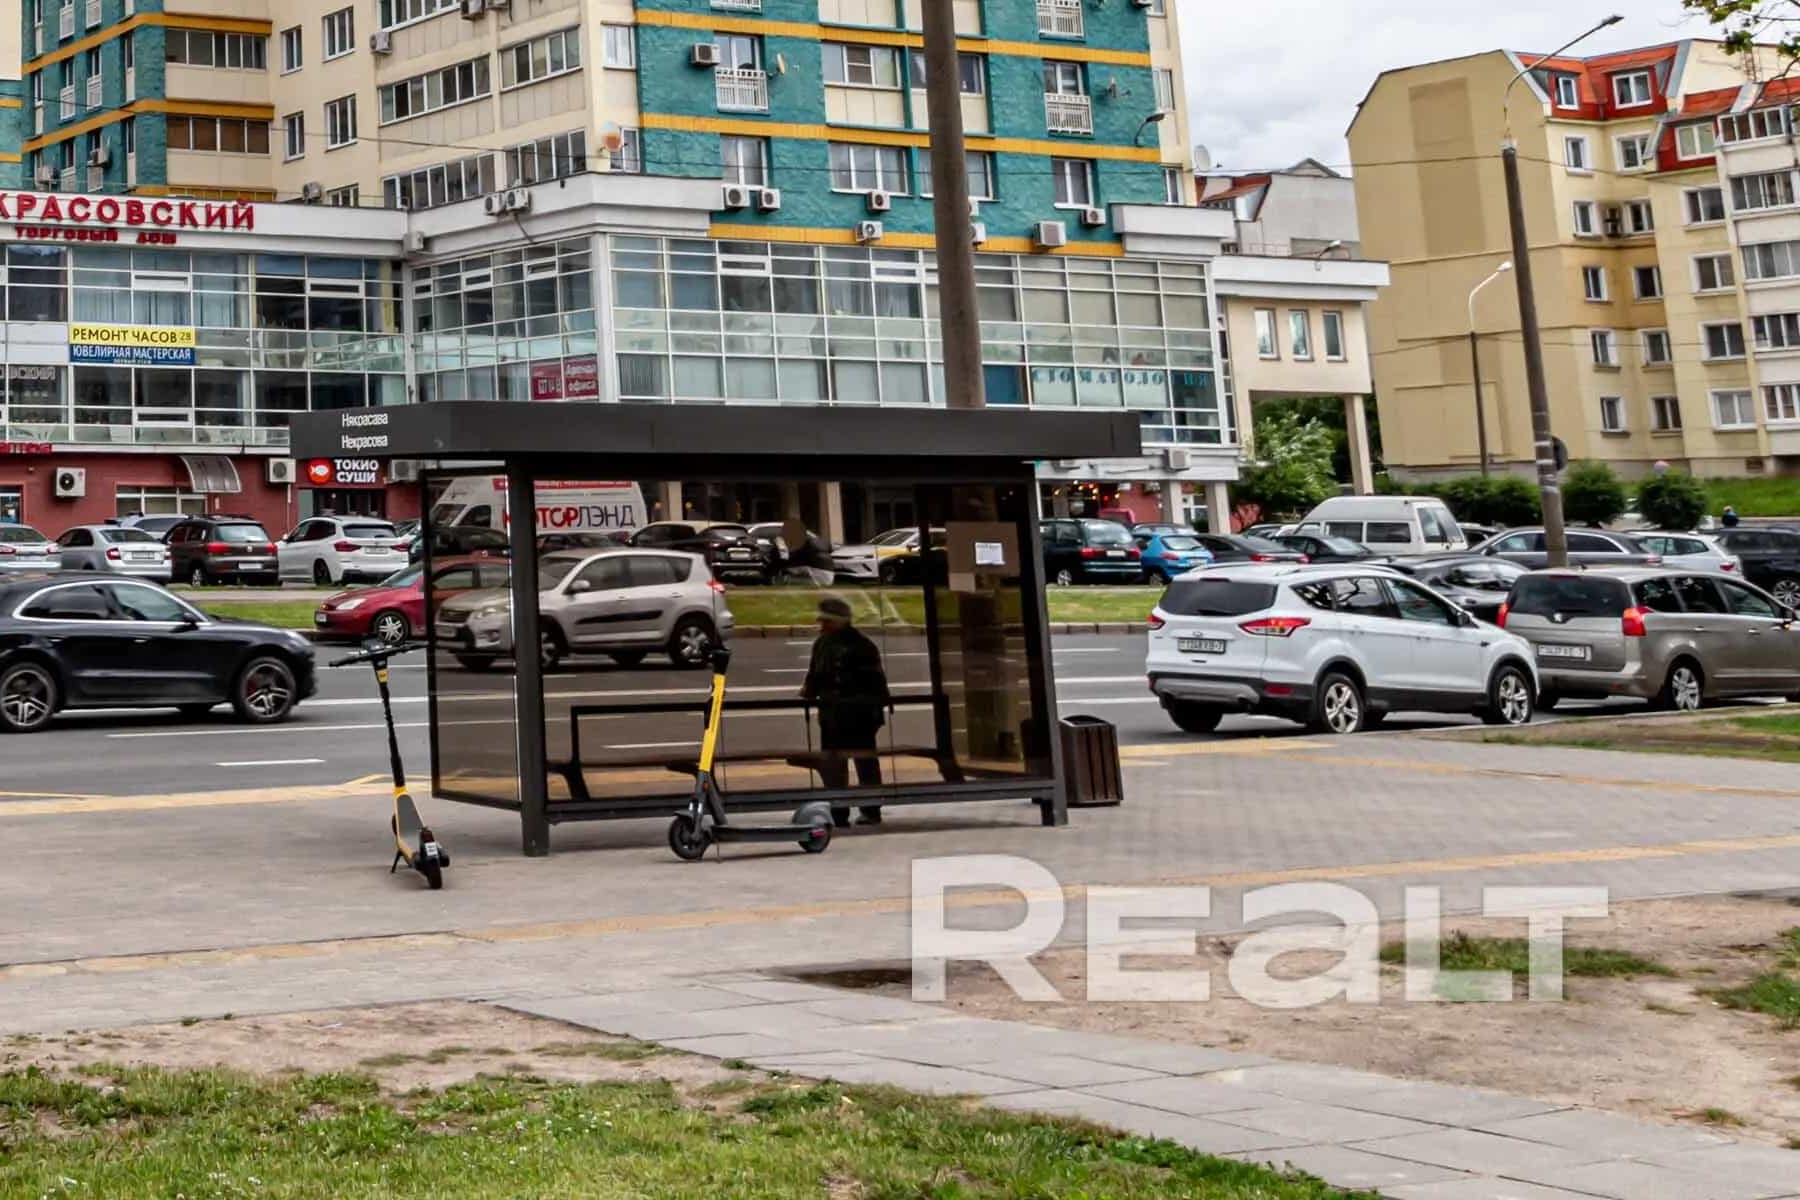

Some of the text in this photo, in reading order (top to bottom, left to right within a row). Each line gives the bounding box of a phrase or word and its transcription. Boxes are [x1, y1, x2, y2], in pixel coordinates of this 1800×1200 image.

[15, 226, 177, 244] ТОРГОВЫЙ ДОМ
[72, 328, 129, 341] РЕМОНТ
[132, 330, 178, 343] ЧАСОВ
[72, 344, 191, 360] ЮВЕЛИРНАЯ МАСТЕРСКАЯ
[341, 435, 388, 452] Некрасова
[334, 459, 379, 471] ТОКИО
[336, 471, 376, 483] СУШИ
[503, 504, 636, 529] ТОРЛЭНД
